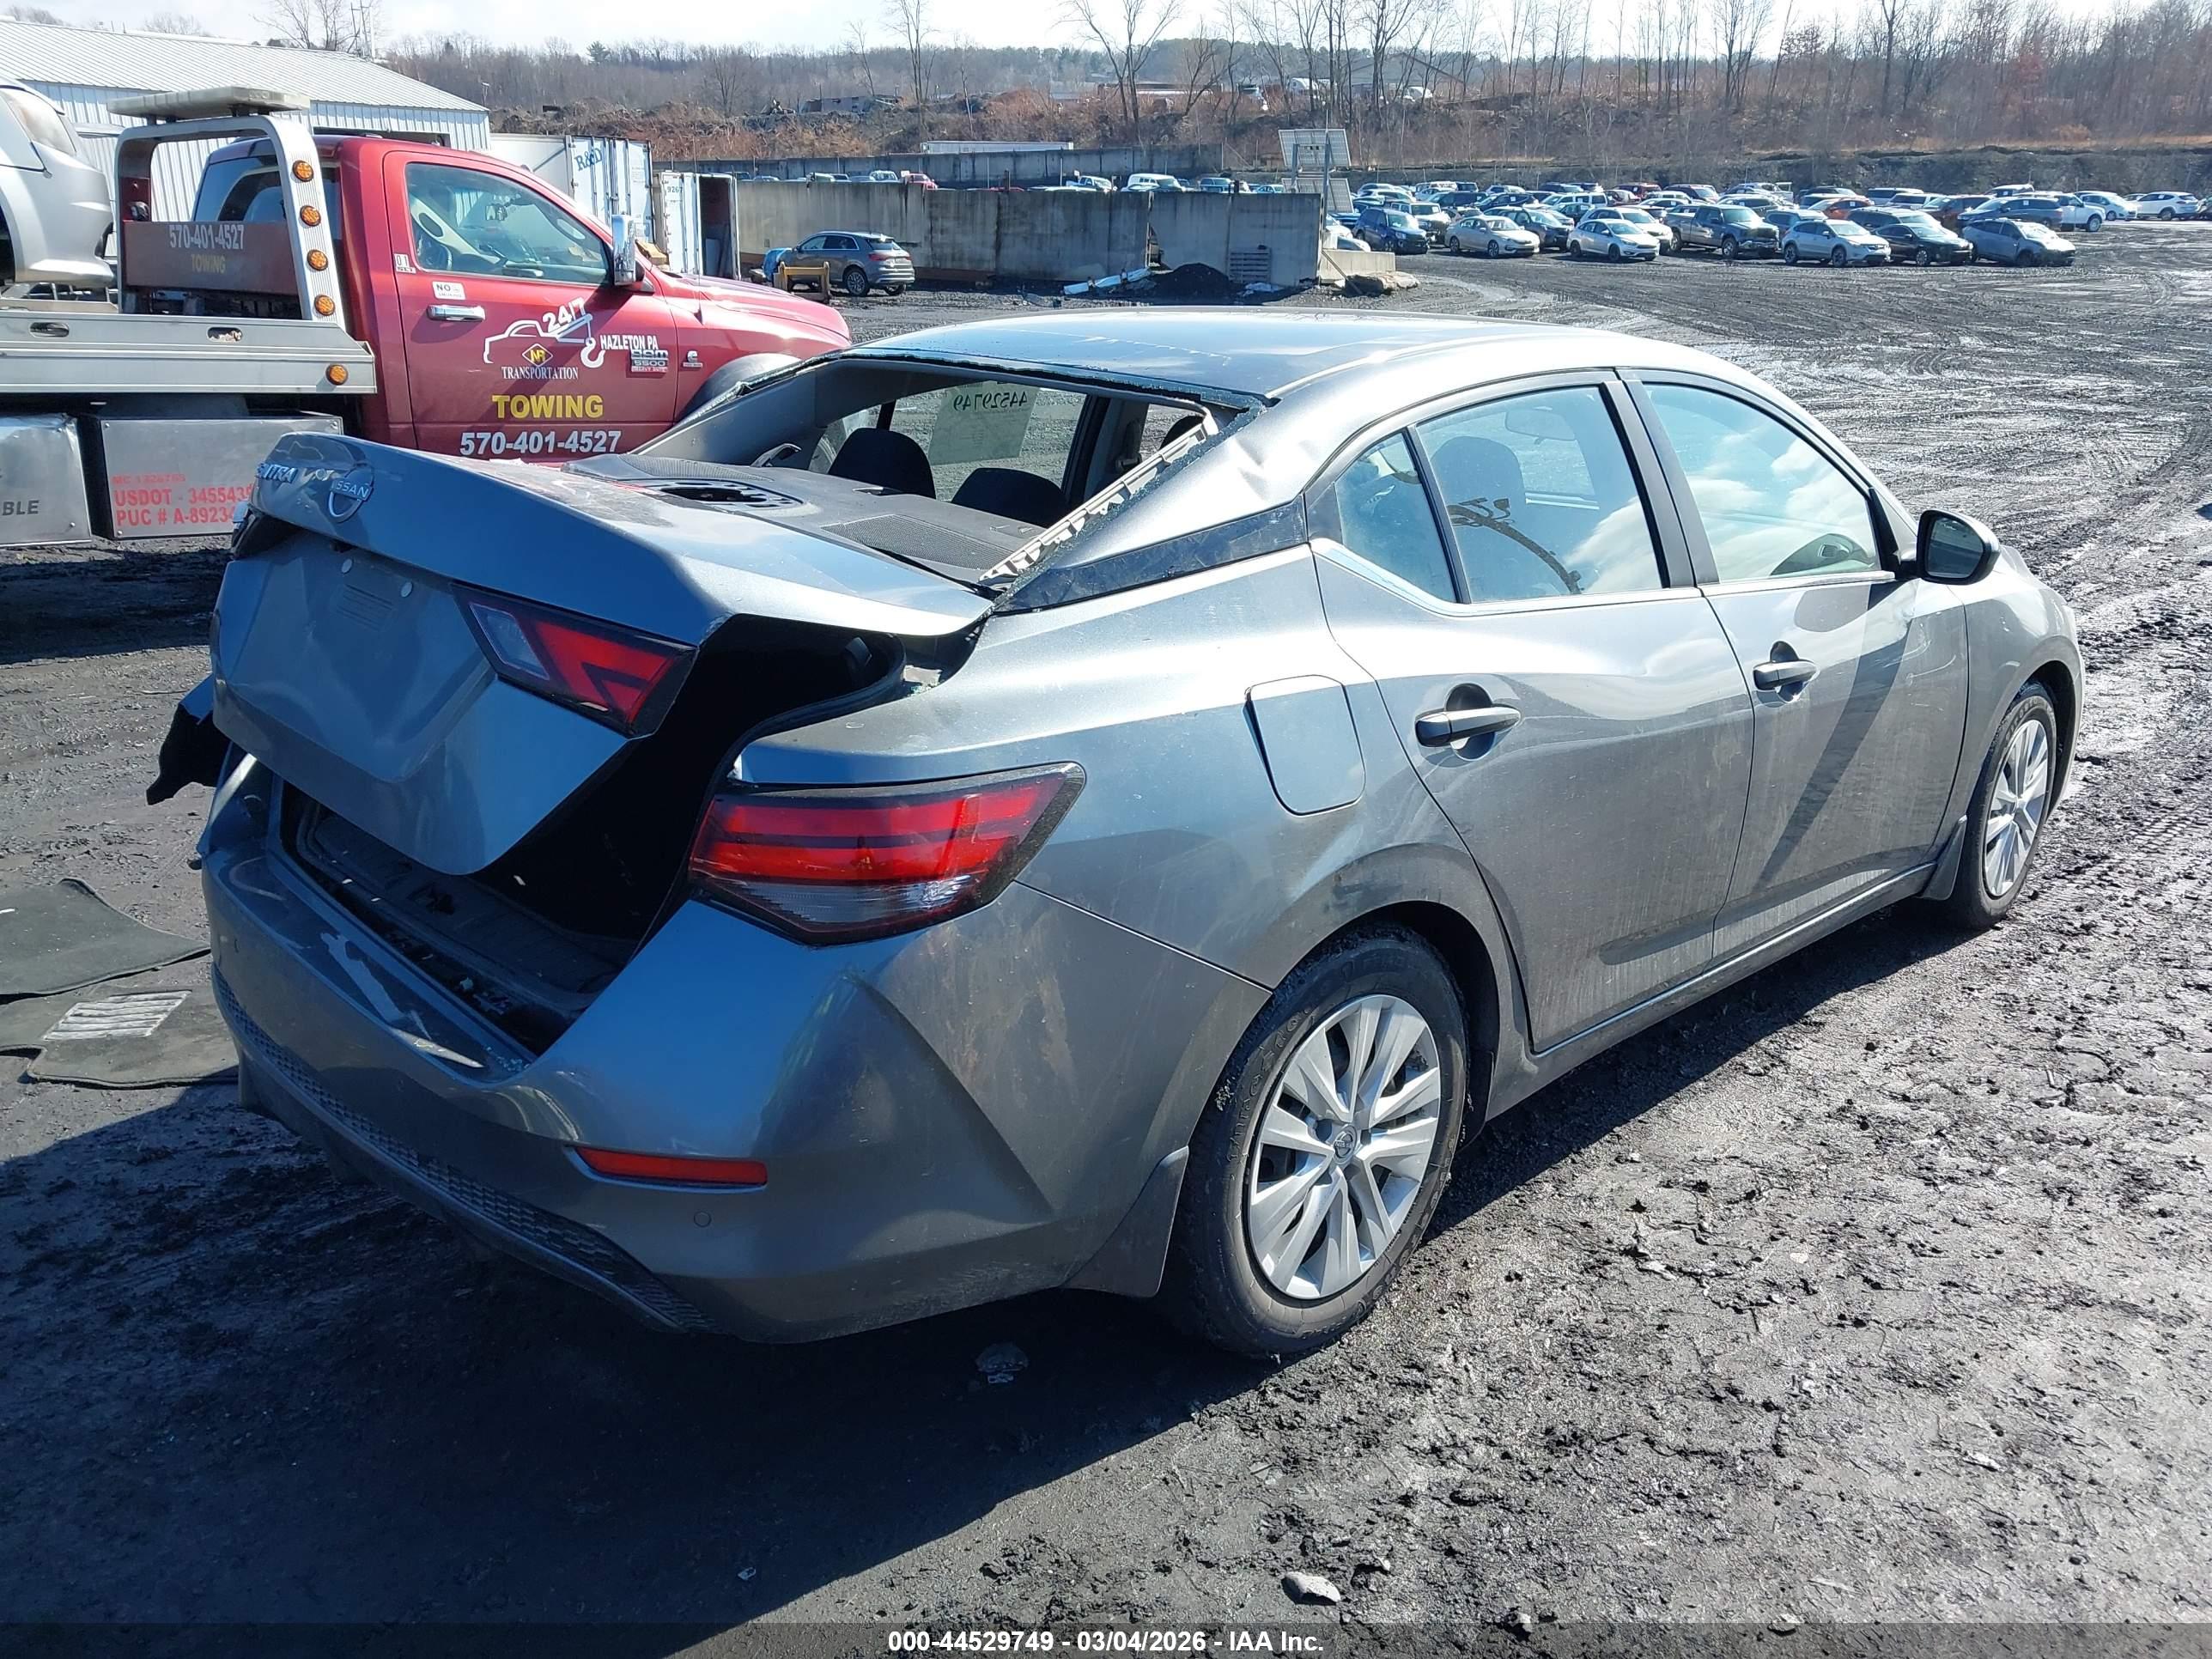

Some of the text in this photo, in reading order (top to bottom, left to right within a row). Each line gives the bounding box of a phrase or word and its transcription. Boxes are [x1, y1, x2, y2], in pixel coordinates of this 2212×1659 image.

[169, 224, 245, 249] 570-401-4527
[191, 254, 226, 273] TOWING
[543, 297, 586, 333] 24/7
[599, 334, 659, 350] HAZLETON PA
[501, 367, 578, 380] TRANSPORTATION
[492, 395, 604, 418] TOWING
[459, 430, 622, 456] 570-401-4527
[113, 488, 172, 507] USDOT
[116, 507, 152, 526] PUC
[158, 507, 167, 525] #
